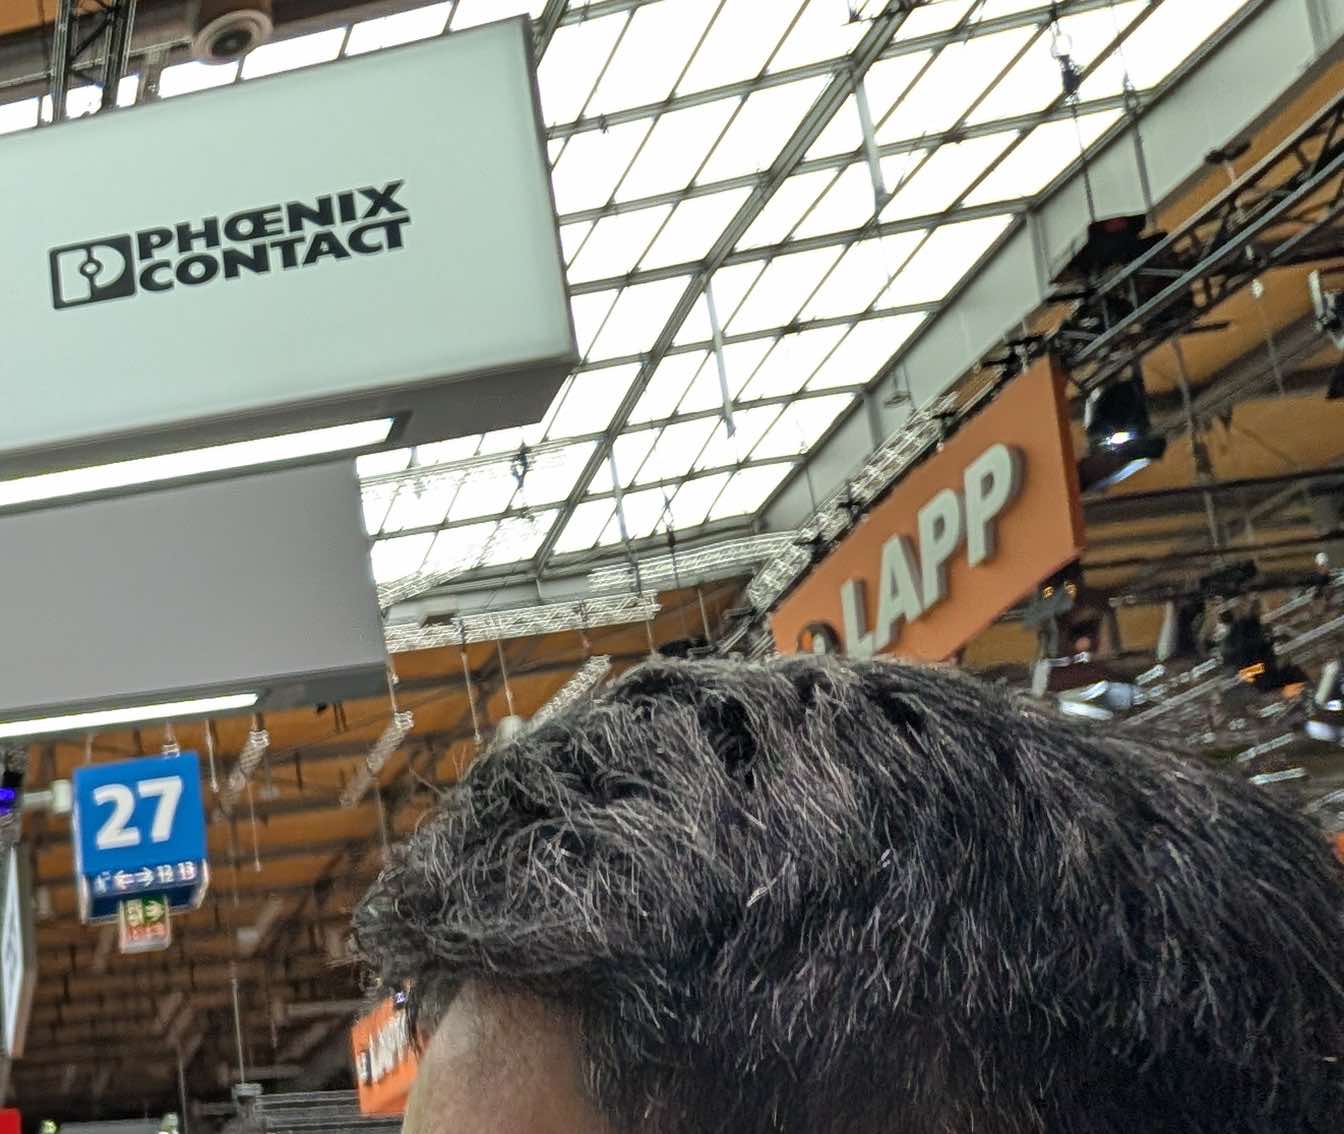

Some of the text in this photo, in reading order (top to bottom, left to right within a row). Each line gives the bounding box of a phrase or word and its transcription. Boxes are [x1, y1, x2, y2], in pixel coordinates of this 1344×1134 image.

[139, 215, 411, 292] CONTACT
[840, 442, 1018, 660] LAPP
[92, 775, 183, 850] 27
